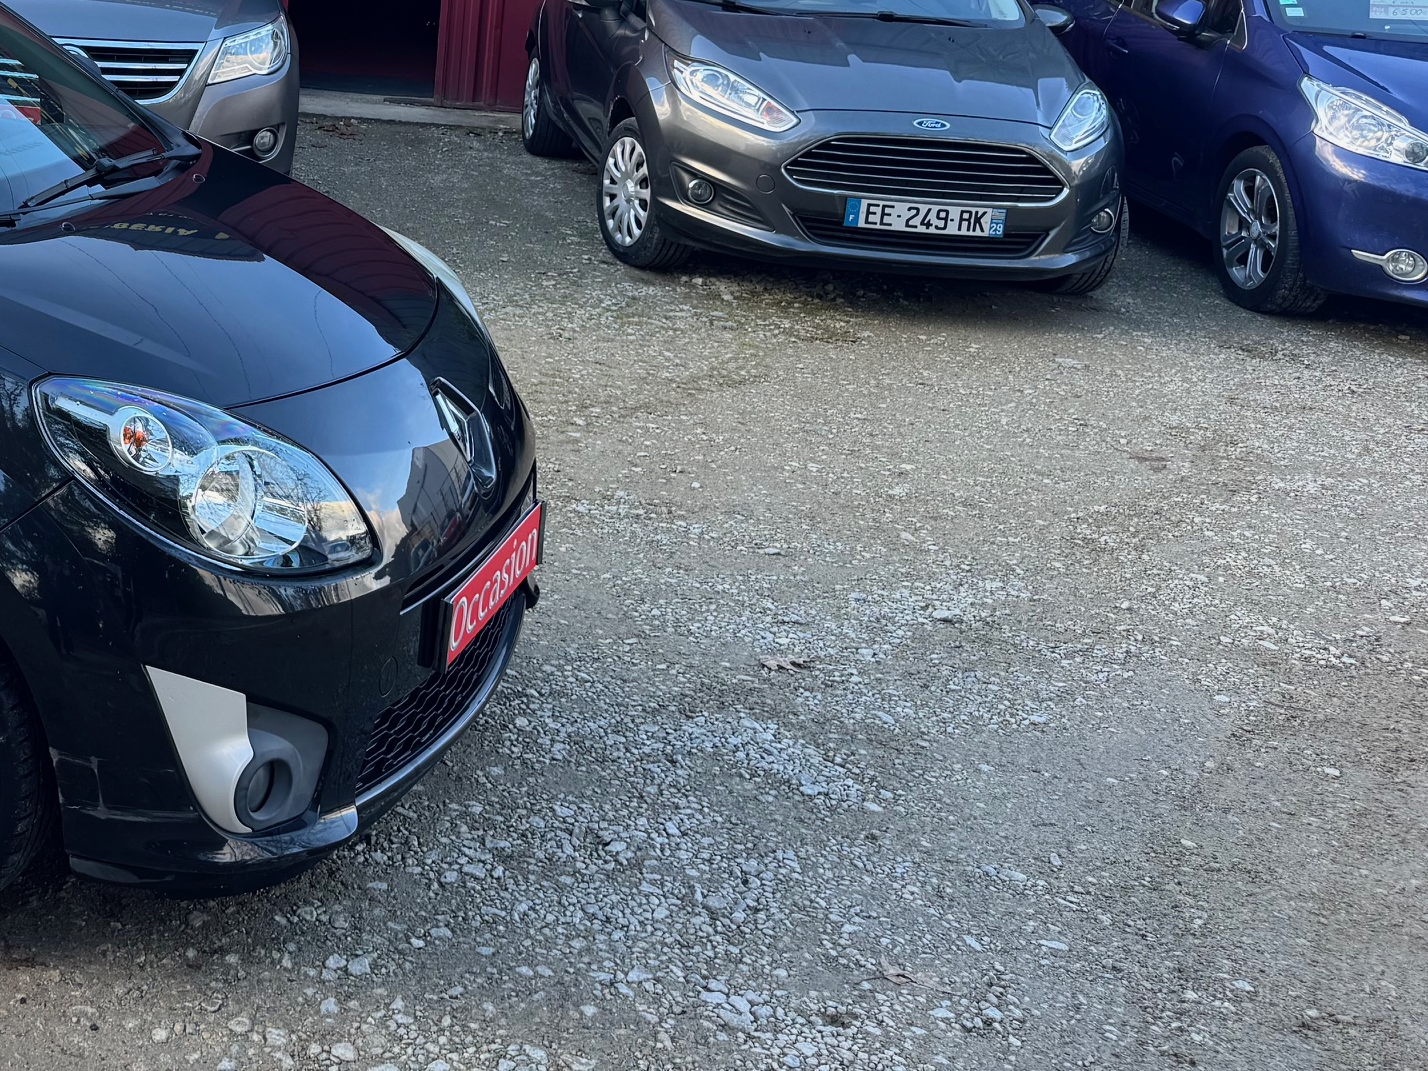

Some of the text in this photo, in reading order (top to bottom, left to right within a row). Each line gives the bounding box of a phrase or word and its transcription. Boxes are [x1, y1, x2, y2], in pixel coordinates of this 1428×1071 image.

[921, 119, 942, 128] Ford
[864, 202, 988, 233] EE-249-RK
[989, 223, 1003, 235] 29
[450, 528, 538, 652] Occasion
